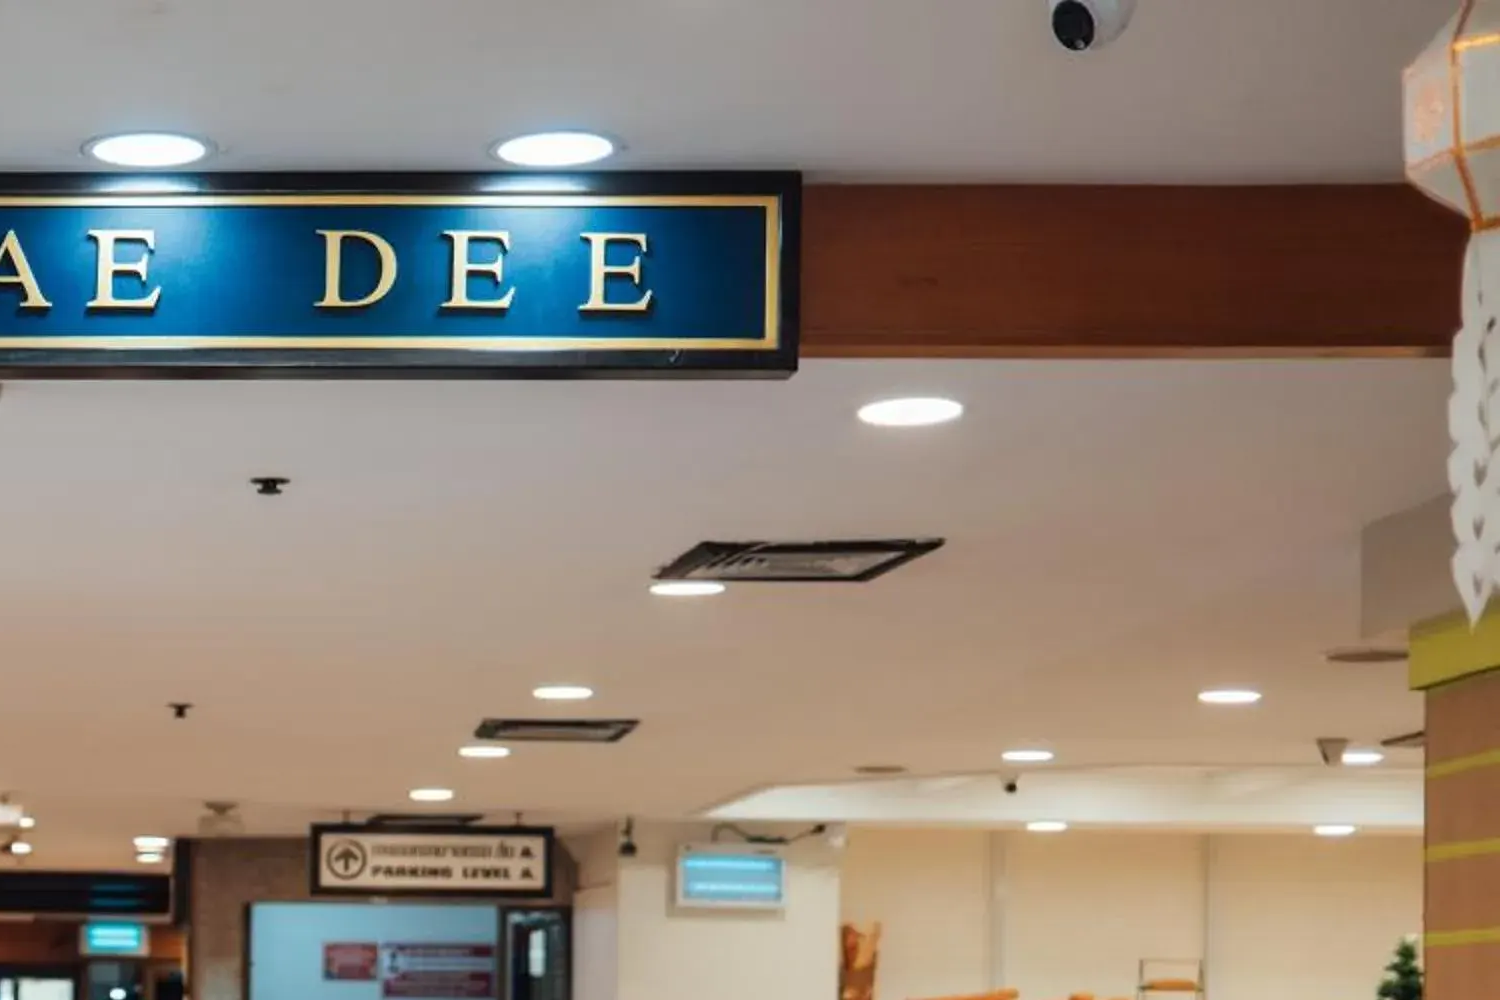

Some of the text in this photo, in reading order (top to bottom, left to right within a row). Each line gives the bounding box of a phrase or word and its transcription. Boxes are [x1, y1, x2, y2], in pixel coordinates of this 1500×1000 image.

[313, 228, 654, 312] DEE
[370, 865, 534, 880] PARKING LEVEL A
